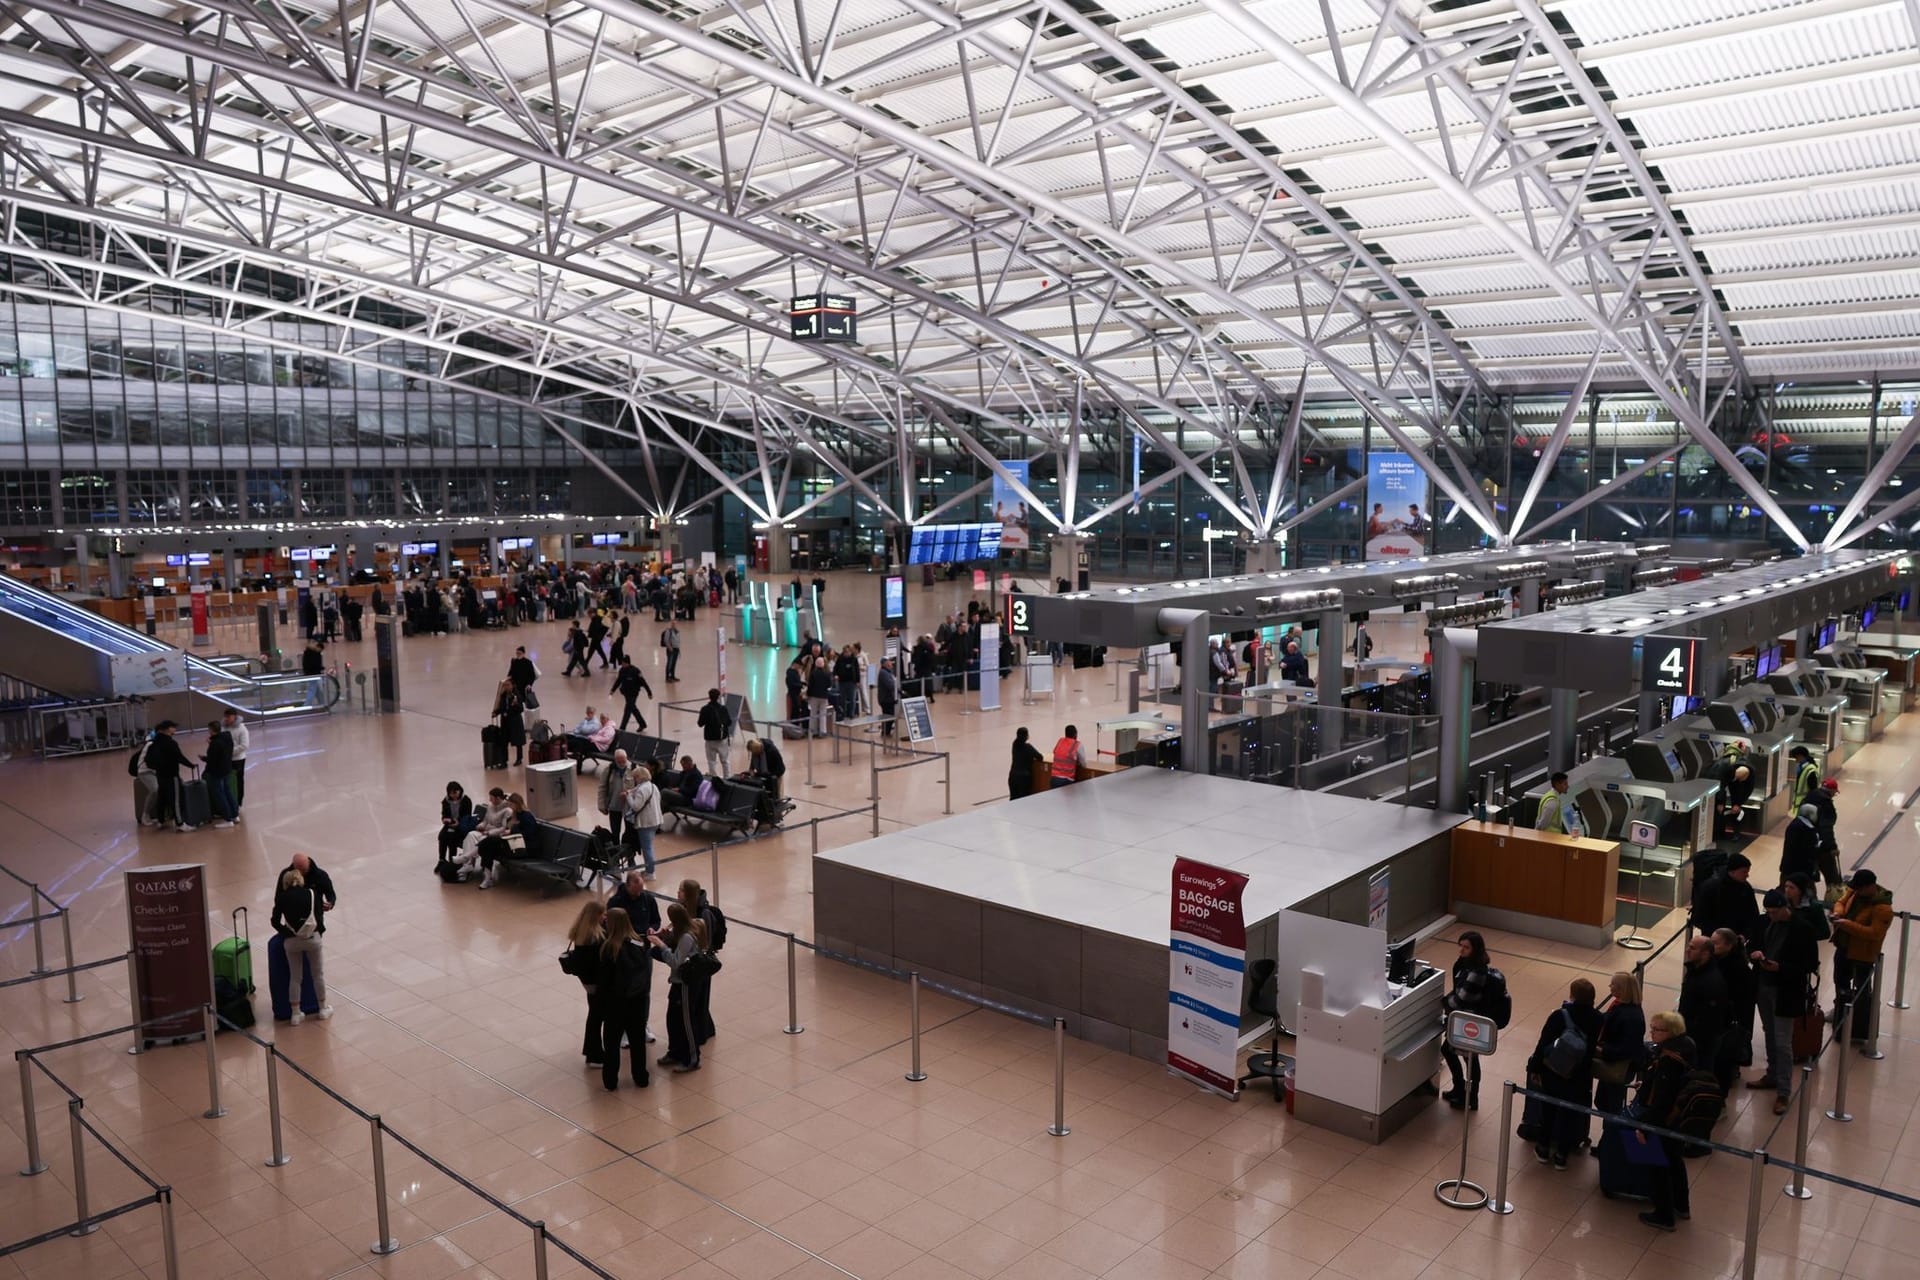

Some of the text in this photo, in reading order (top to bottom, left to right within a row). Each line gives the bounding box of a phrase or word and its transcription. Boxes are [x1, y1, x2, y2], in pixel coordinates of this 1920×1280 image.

[809, 314, 817, 335] 1
[843, 316, 850, 335] 1
[1013, 600, 1027, 625] 3
[1660, 647, 1684, 678] 4
[135, 880, 177, 893] QATAR
[1180, 873, 1217, 891] Eurowings
[134, 904, 179, 915] Check-in
[1179, 889, 1235, 913] BAGGAGE
[1179, 902, 1210, 919] DROP
[167, 923, 186, 931] Class
[171, 937, 189, 947] Gold
